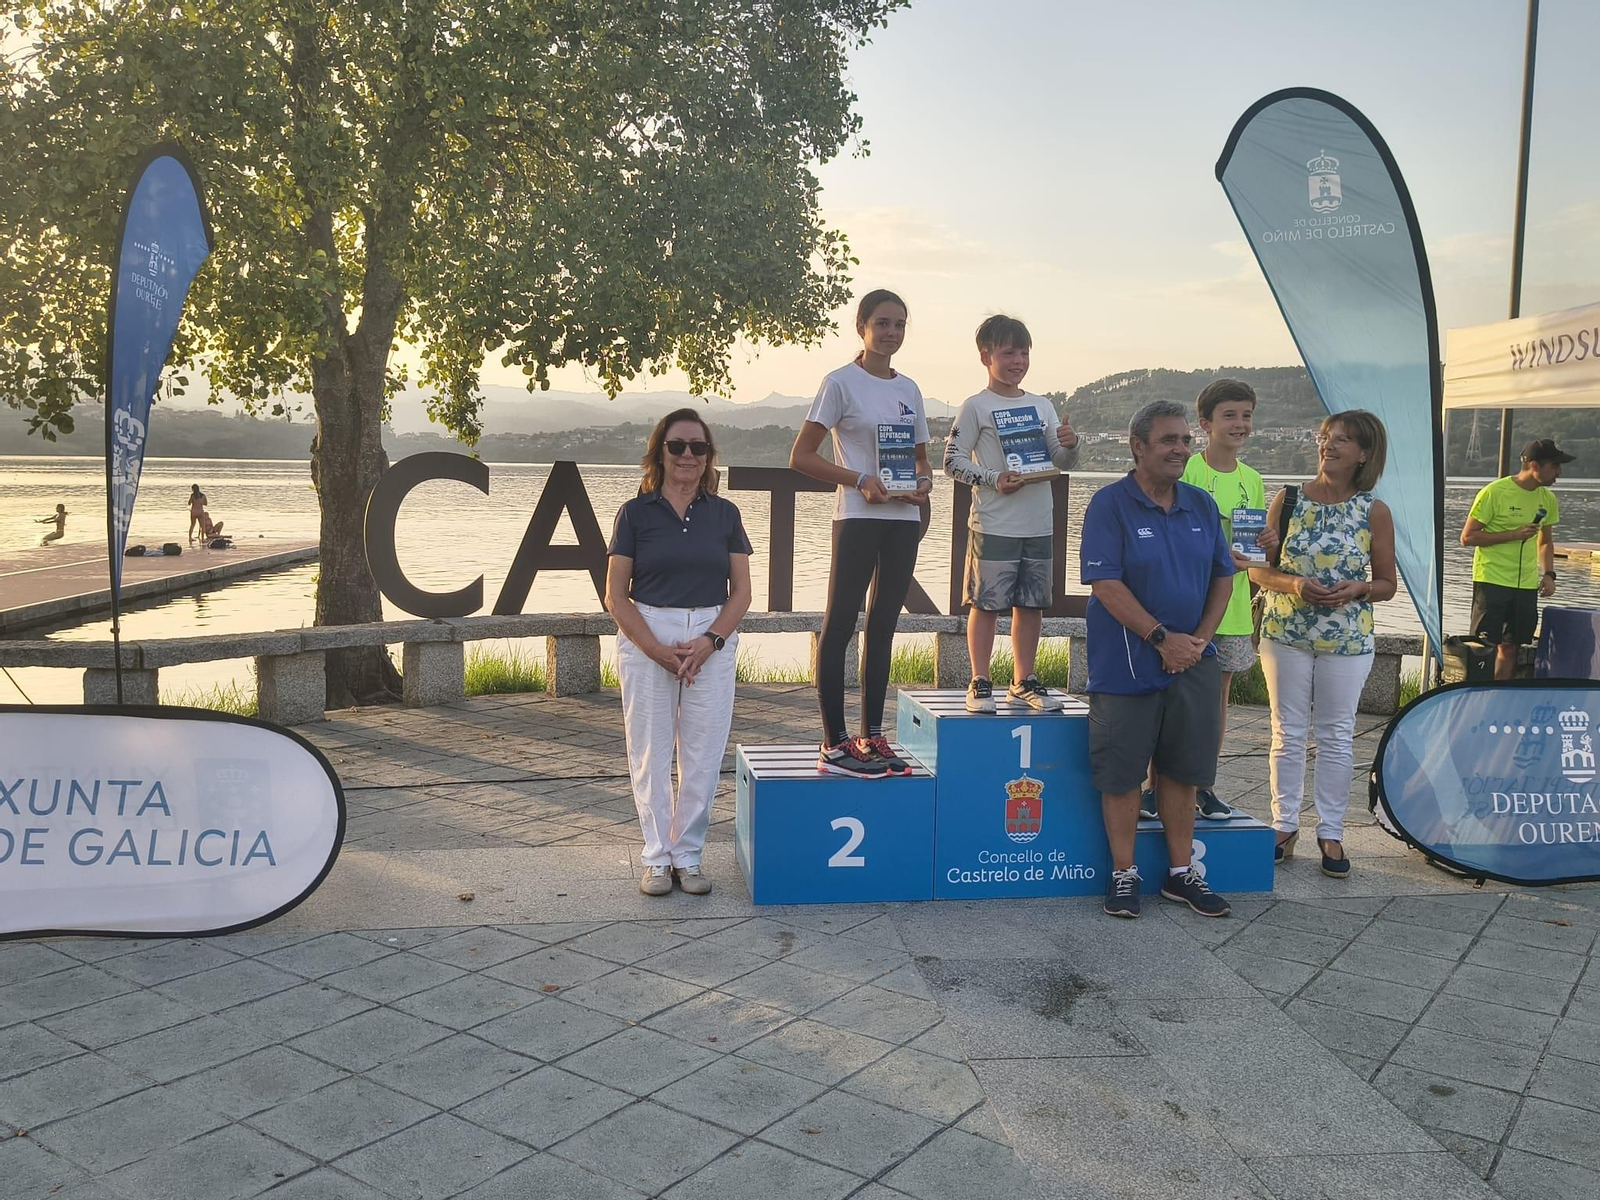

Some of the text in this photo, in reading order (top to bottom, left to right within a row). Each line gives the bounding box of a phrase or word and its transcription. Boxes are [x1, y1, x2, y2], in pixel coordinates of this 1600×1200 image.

[994, 410, 1012, 418] COPA
[1011, 724, 1033, 769] 1
[0, 778, 172, 817] XUNTA
[1491, 792, 1600, 815] DEPUTA
[68, 827, 278, 867] GALICIA
[828, 816, 866, 868] 2
[978, 848, 1066, 864] Concello de
[947, 864, 1096, 884] Castrelo de Miño
